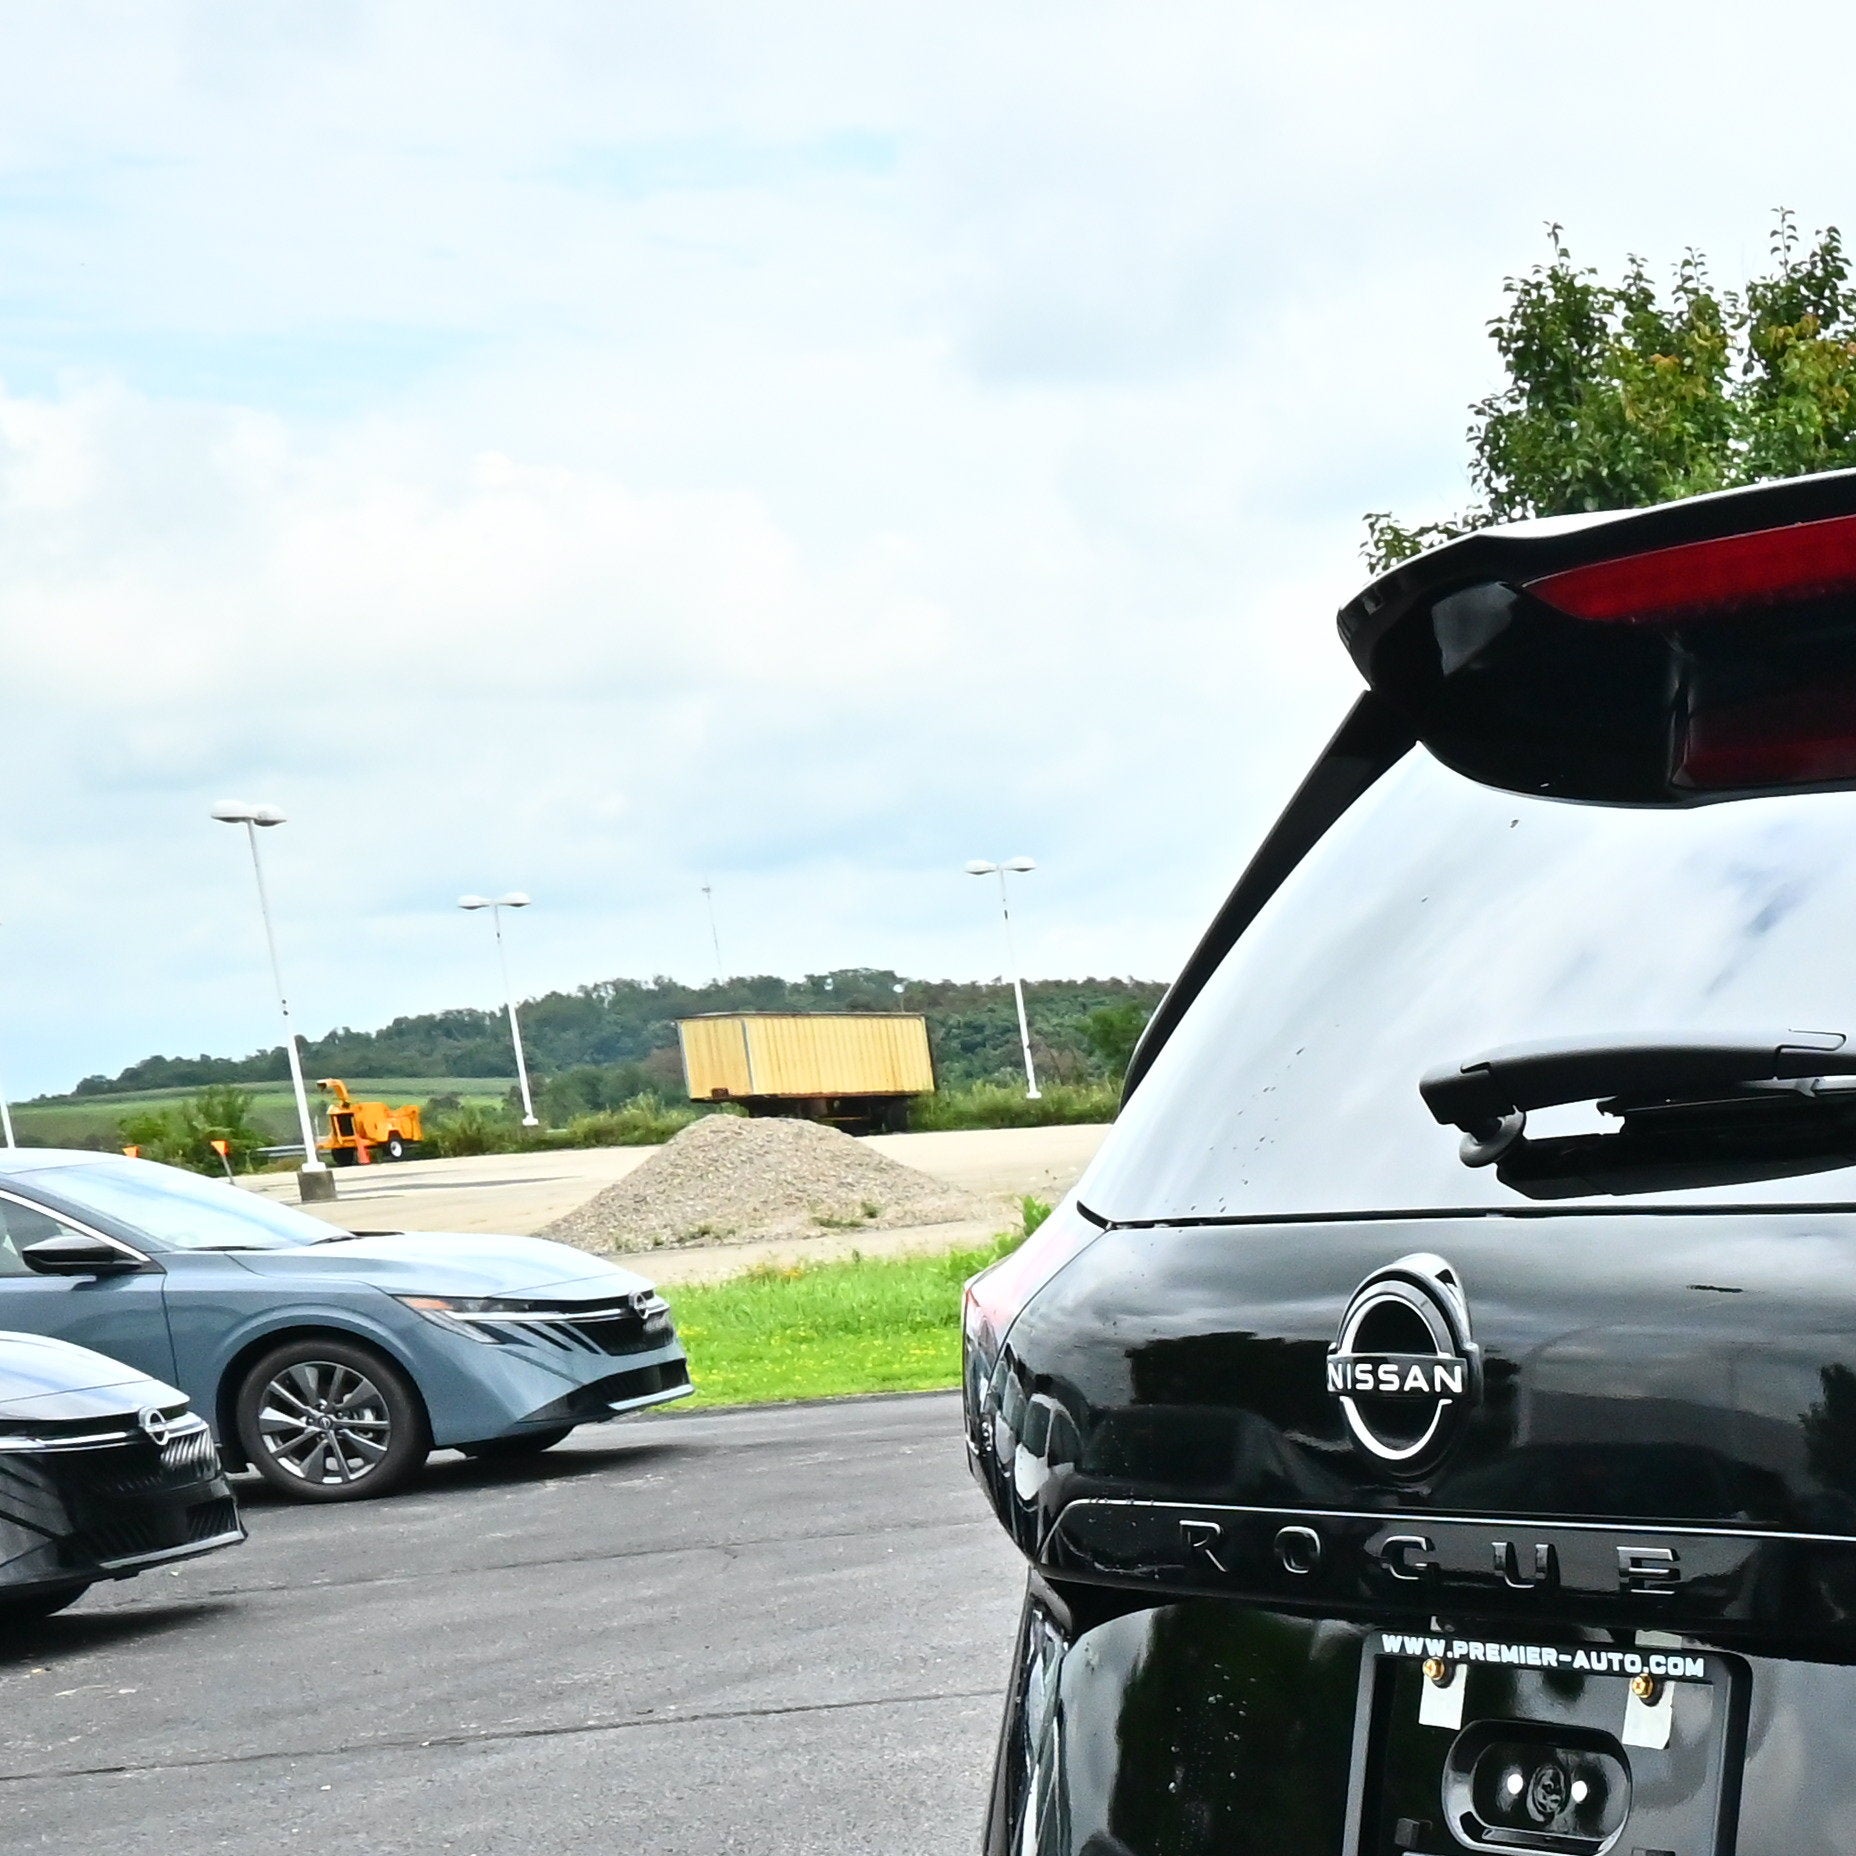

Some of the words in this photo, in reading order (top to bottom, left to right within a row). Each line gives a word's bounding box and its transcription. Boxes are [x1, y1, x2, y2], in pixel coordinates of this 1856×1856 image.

[1327, 1363, 1463, 1394] NISSAN
[1179, 1519, 1682, 1595] ROGUE
[1381, 1633, 1705, 1679] WWW.PREMIER-AUTO.COM
